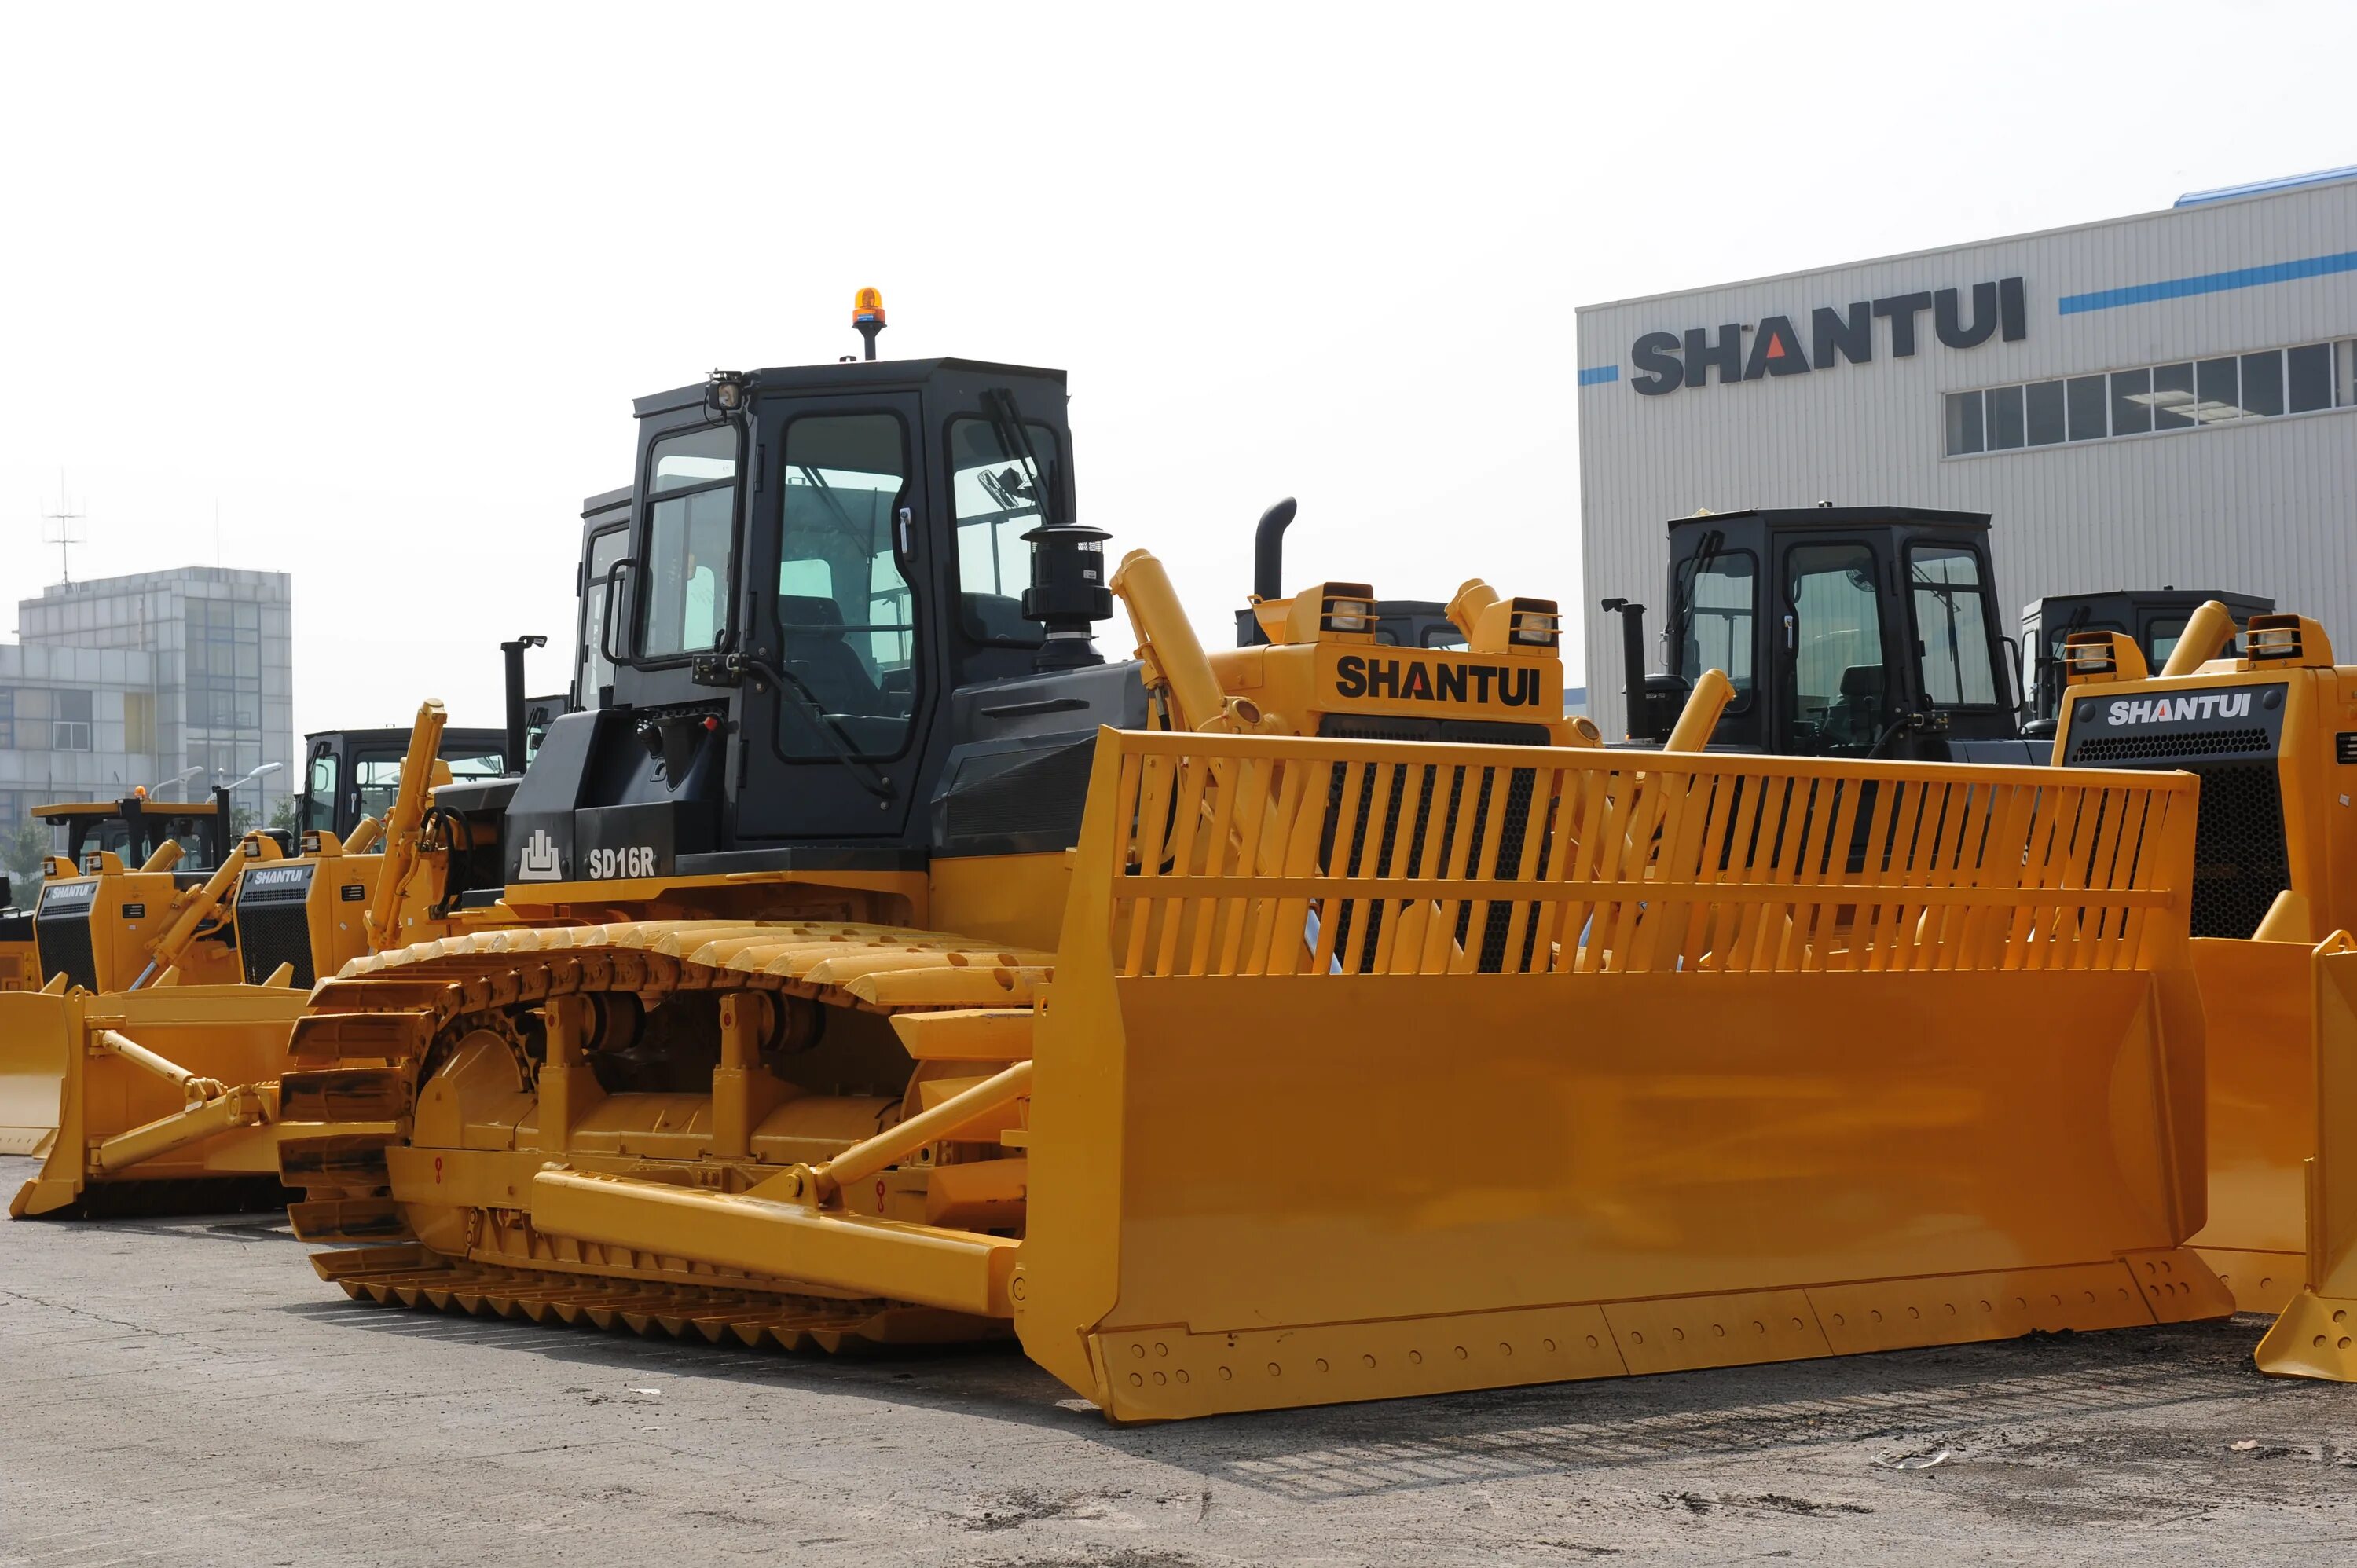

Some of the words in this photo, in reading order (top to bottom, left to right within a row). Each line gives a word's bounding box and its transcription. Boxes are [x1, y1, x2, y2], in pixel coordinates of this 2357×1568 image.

[1630, 276, 2026, 396] SHANTUI
[1336, 656, 1540, 707] SHANTUI
[2107, 693, 2251, 725] SHANTUI
[255, 869, 302, 885] SHANTUI
[589, 847, 655, 879] SD16R
[52, 885, 89, 899] SHANTUI
